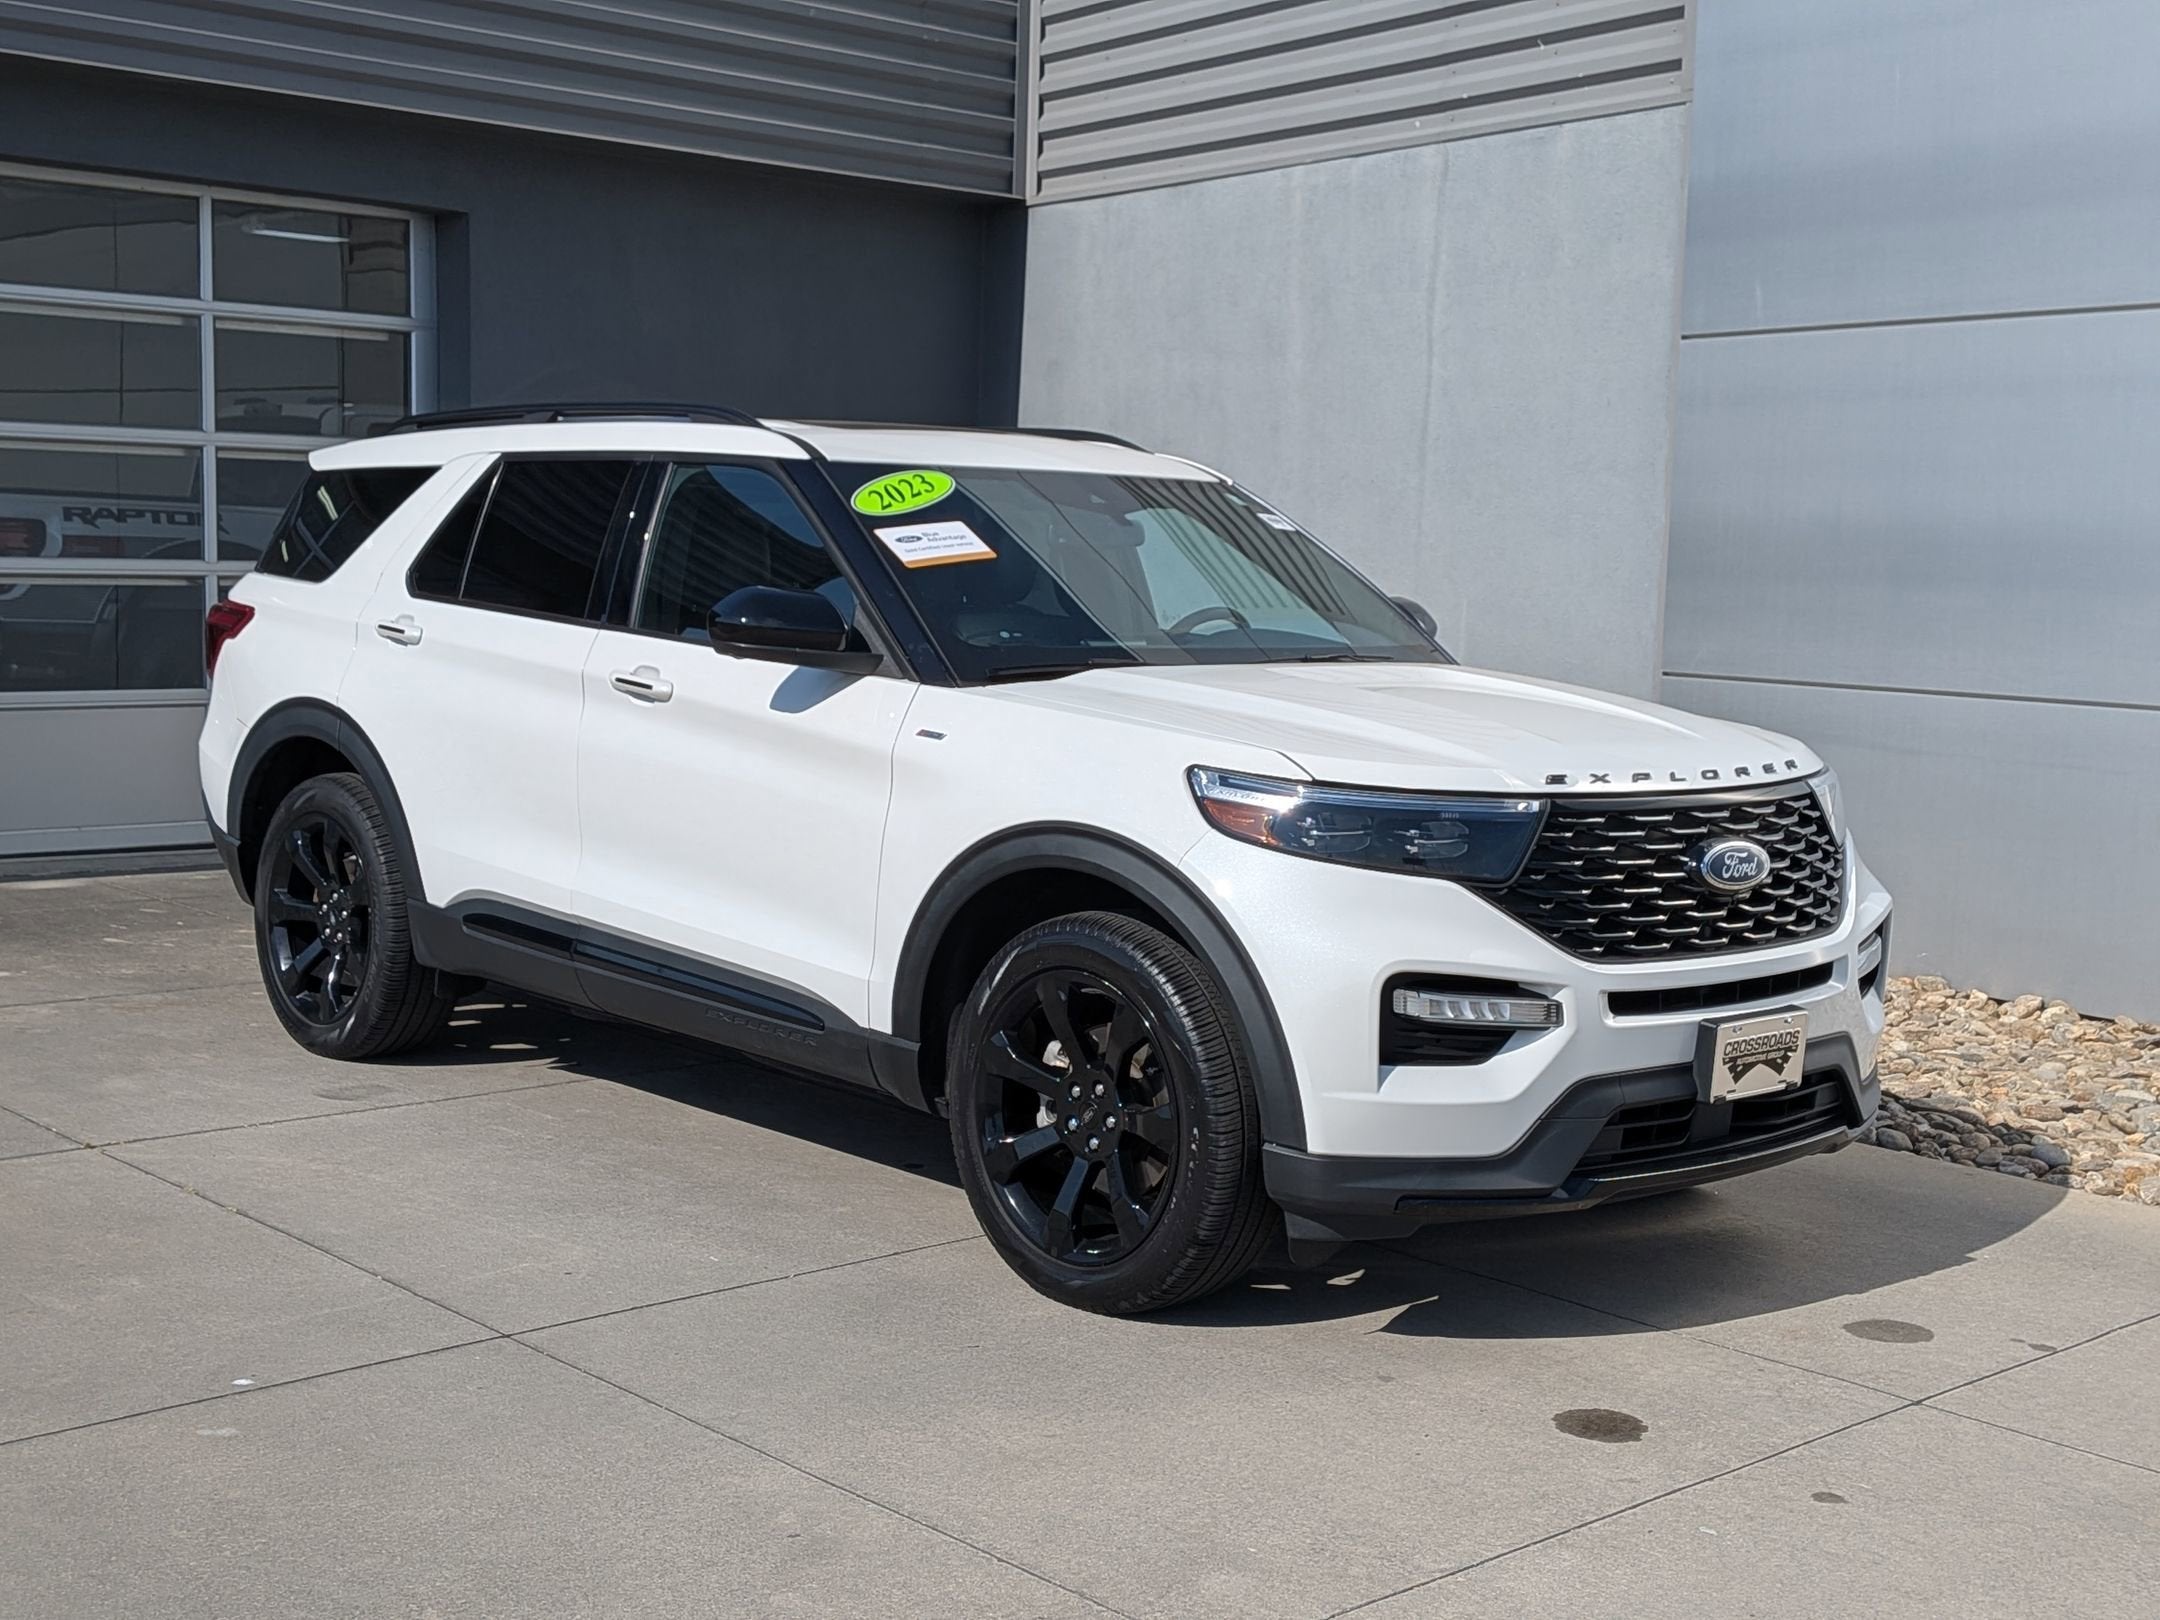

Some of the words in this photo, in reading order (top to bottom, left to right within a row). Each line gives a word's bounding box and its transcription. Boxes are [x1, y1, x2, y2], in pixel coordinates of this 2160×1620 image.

[868, 474, 935, 511] 2023
[1545, 758, 1798, 786] EXPLORER
[1722, 851, 1758, 878] Ford
[1723, 1029, 1800, 1056] CROSSROADS
